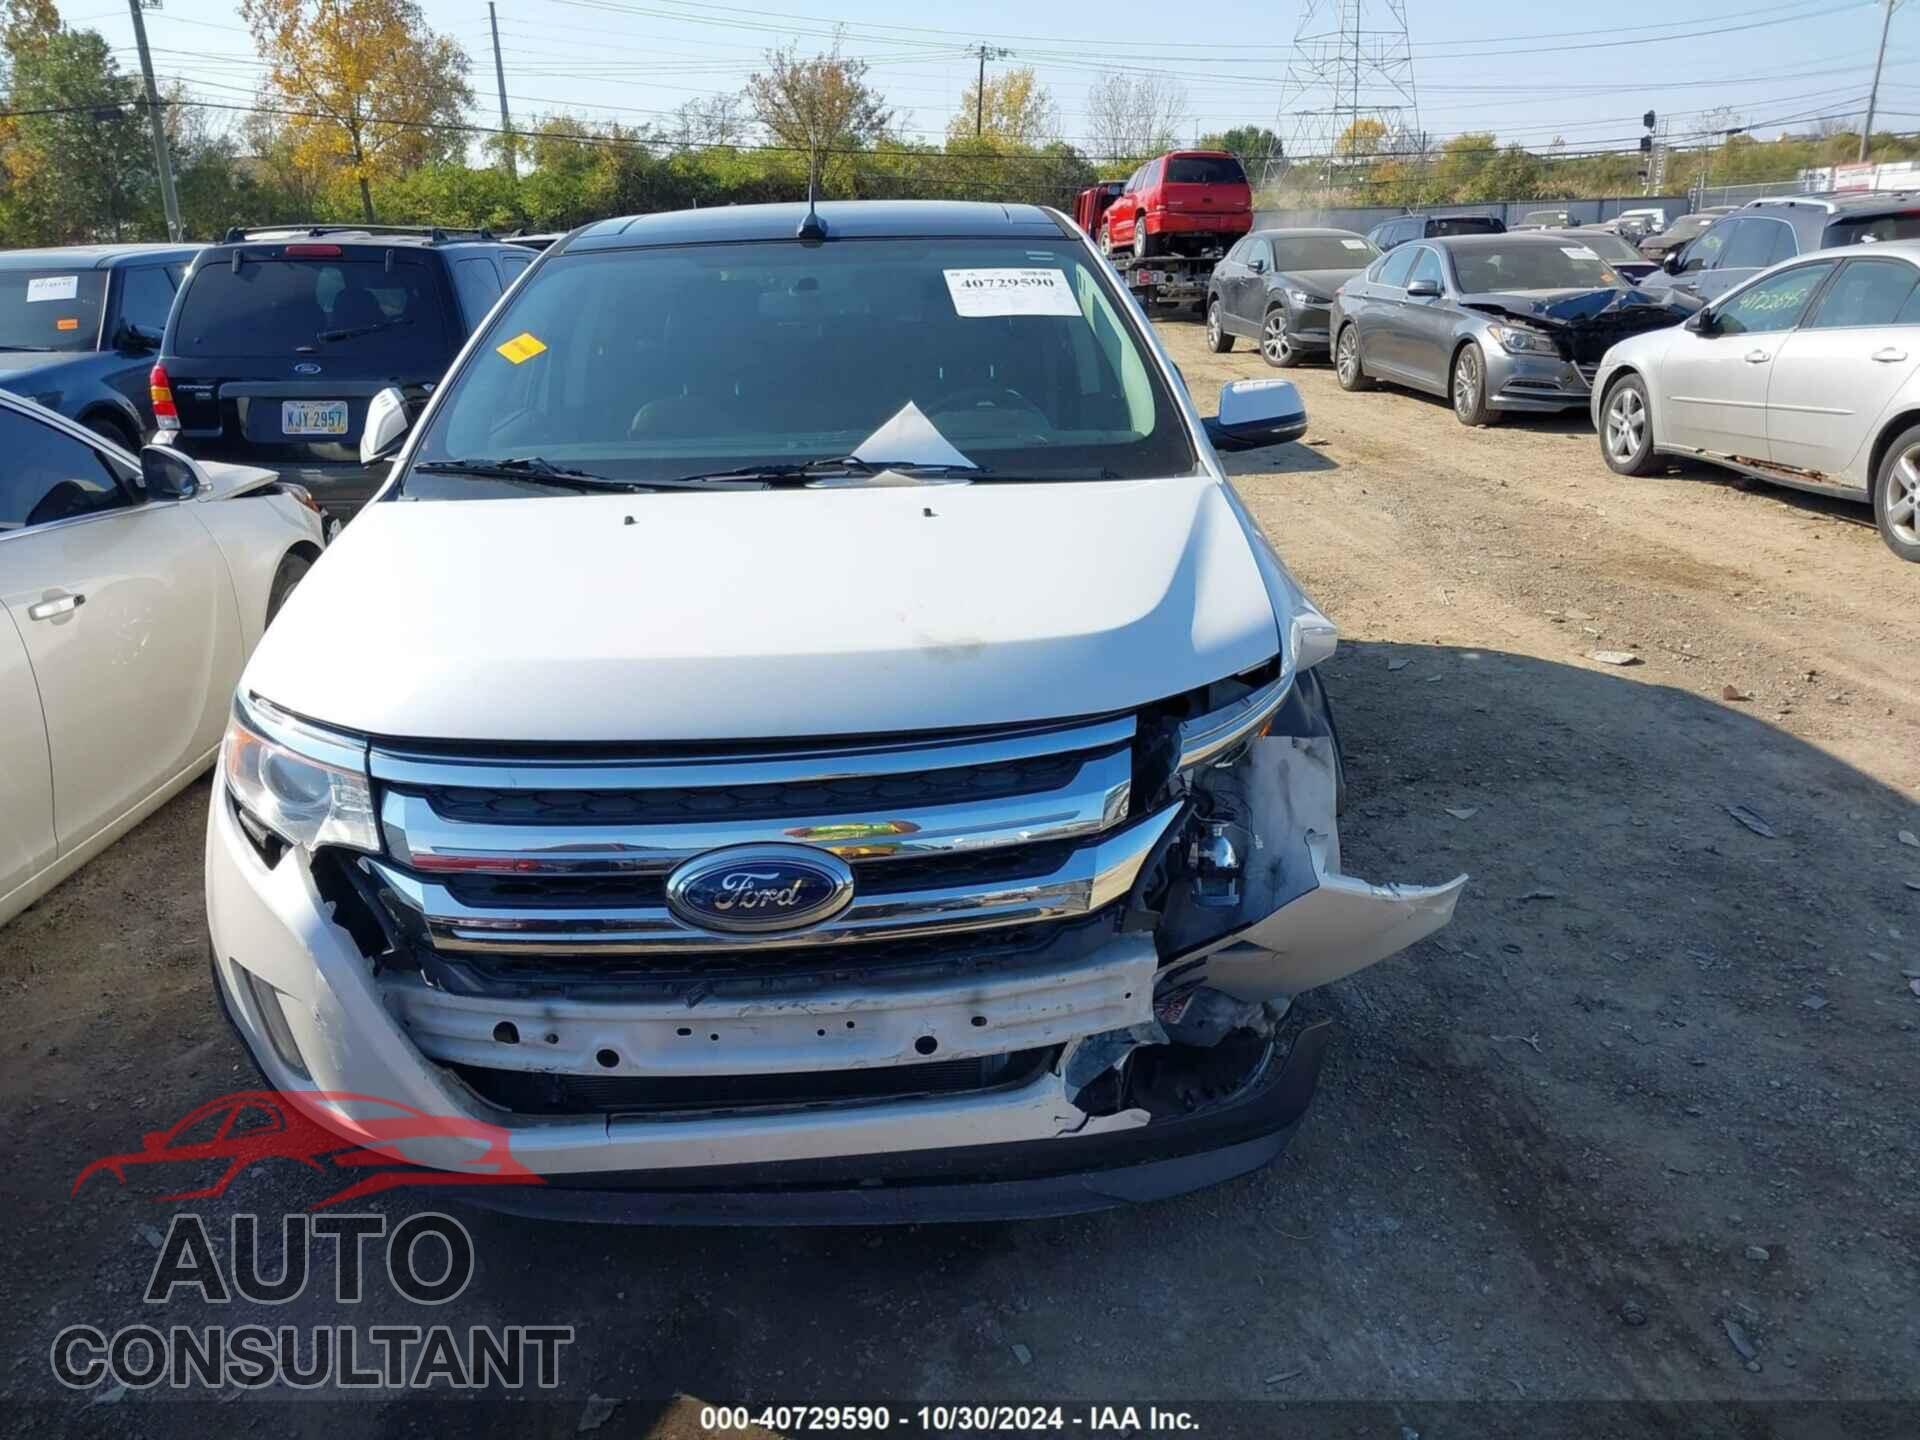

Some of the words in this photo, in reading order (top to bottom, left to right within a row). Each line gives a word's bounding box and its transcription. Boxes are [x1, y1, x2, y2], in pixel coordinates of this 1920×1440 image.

[961, 278, 1055, 289] 40729590
[313, 410, 343, 428] 2957
[713, 871, 803, 911] Ford
